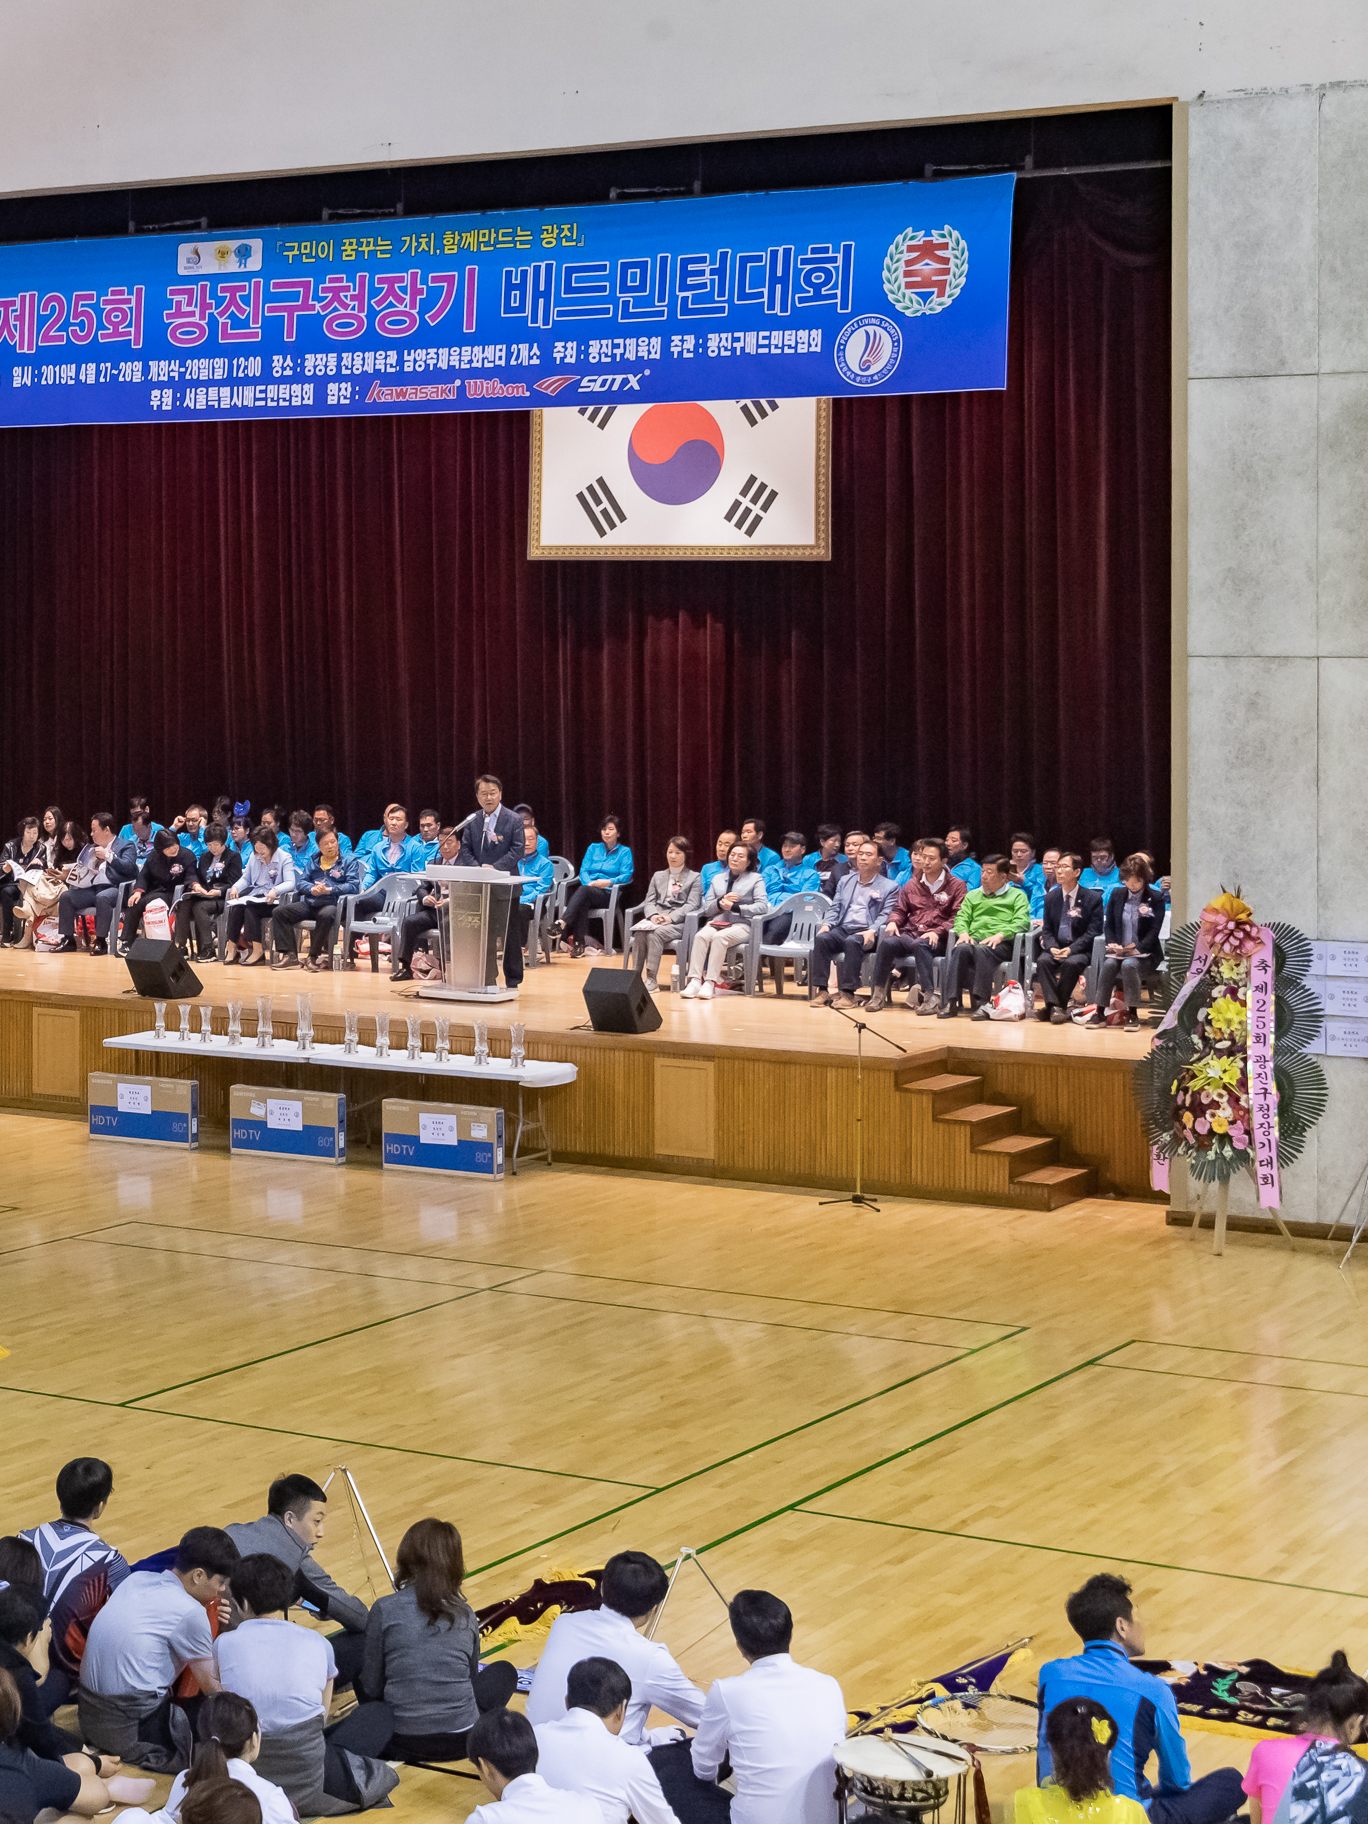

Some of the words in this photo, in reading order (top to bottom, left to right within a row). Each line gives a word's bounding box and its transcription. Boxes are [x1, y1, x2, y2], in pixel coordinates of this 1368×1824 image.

[340, 236, 393, 261] 꿈꾸는
[903, 238, 952, 299] 축
[163, 265, 479, 347] 광진구청장기
[501, 242, 855, 329] 배드민턴대회
[839, 321, 859, 345] PEOPLE
[858, 317, 881, 327] LIVING
[880, 320, 899, 341] SPORTS
[12, 366, 32, 388] 일시
[40, 364, 76, 386] 2019년
[79, 362, 96, 384] 4월
[232, 356, 262, 378] 12:00
[272, 354, 294, 378] 장소
[304, 352, 338, 376] 광장동
[403, 343, 507, 372] 남양주체육문화센터
[510, 342, 541, 366] 2개소
[553, 340, 578, 365] 주최
[588, 336, 662, 363] 광진구체육회
[670, 334, 695, 359] 주관
[707, 328, 822, 357] 광진구배드민턴협회
[149, 388, 173, 411] 후원
[183, 382, 315, 410] 서울특별시배드민턴협회
[326, 381, 352, 405] 협찬
[577, 372, 643, 393] SOTX
[1253, 958, 1272, 976] 축
[1251, 981, 1269, 1048] 제25회
[1252, 1054, 1276, 1189] 광진구청장기대회
